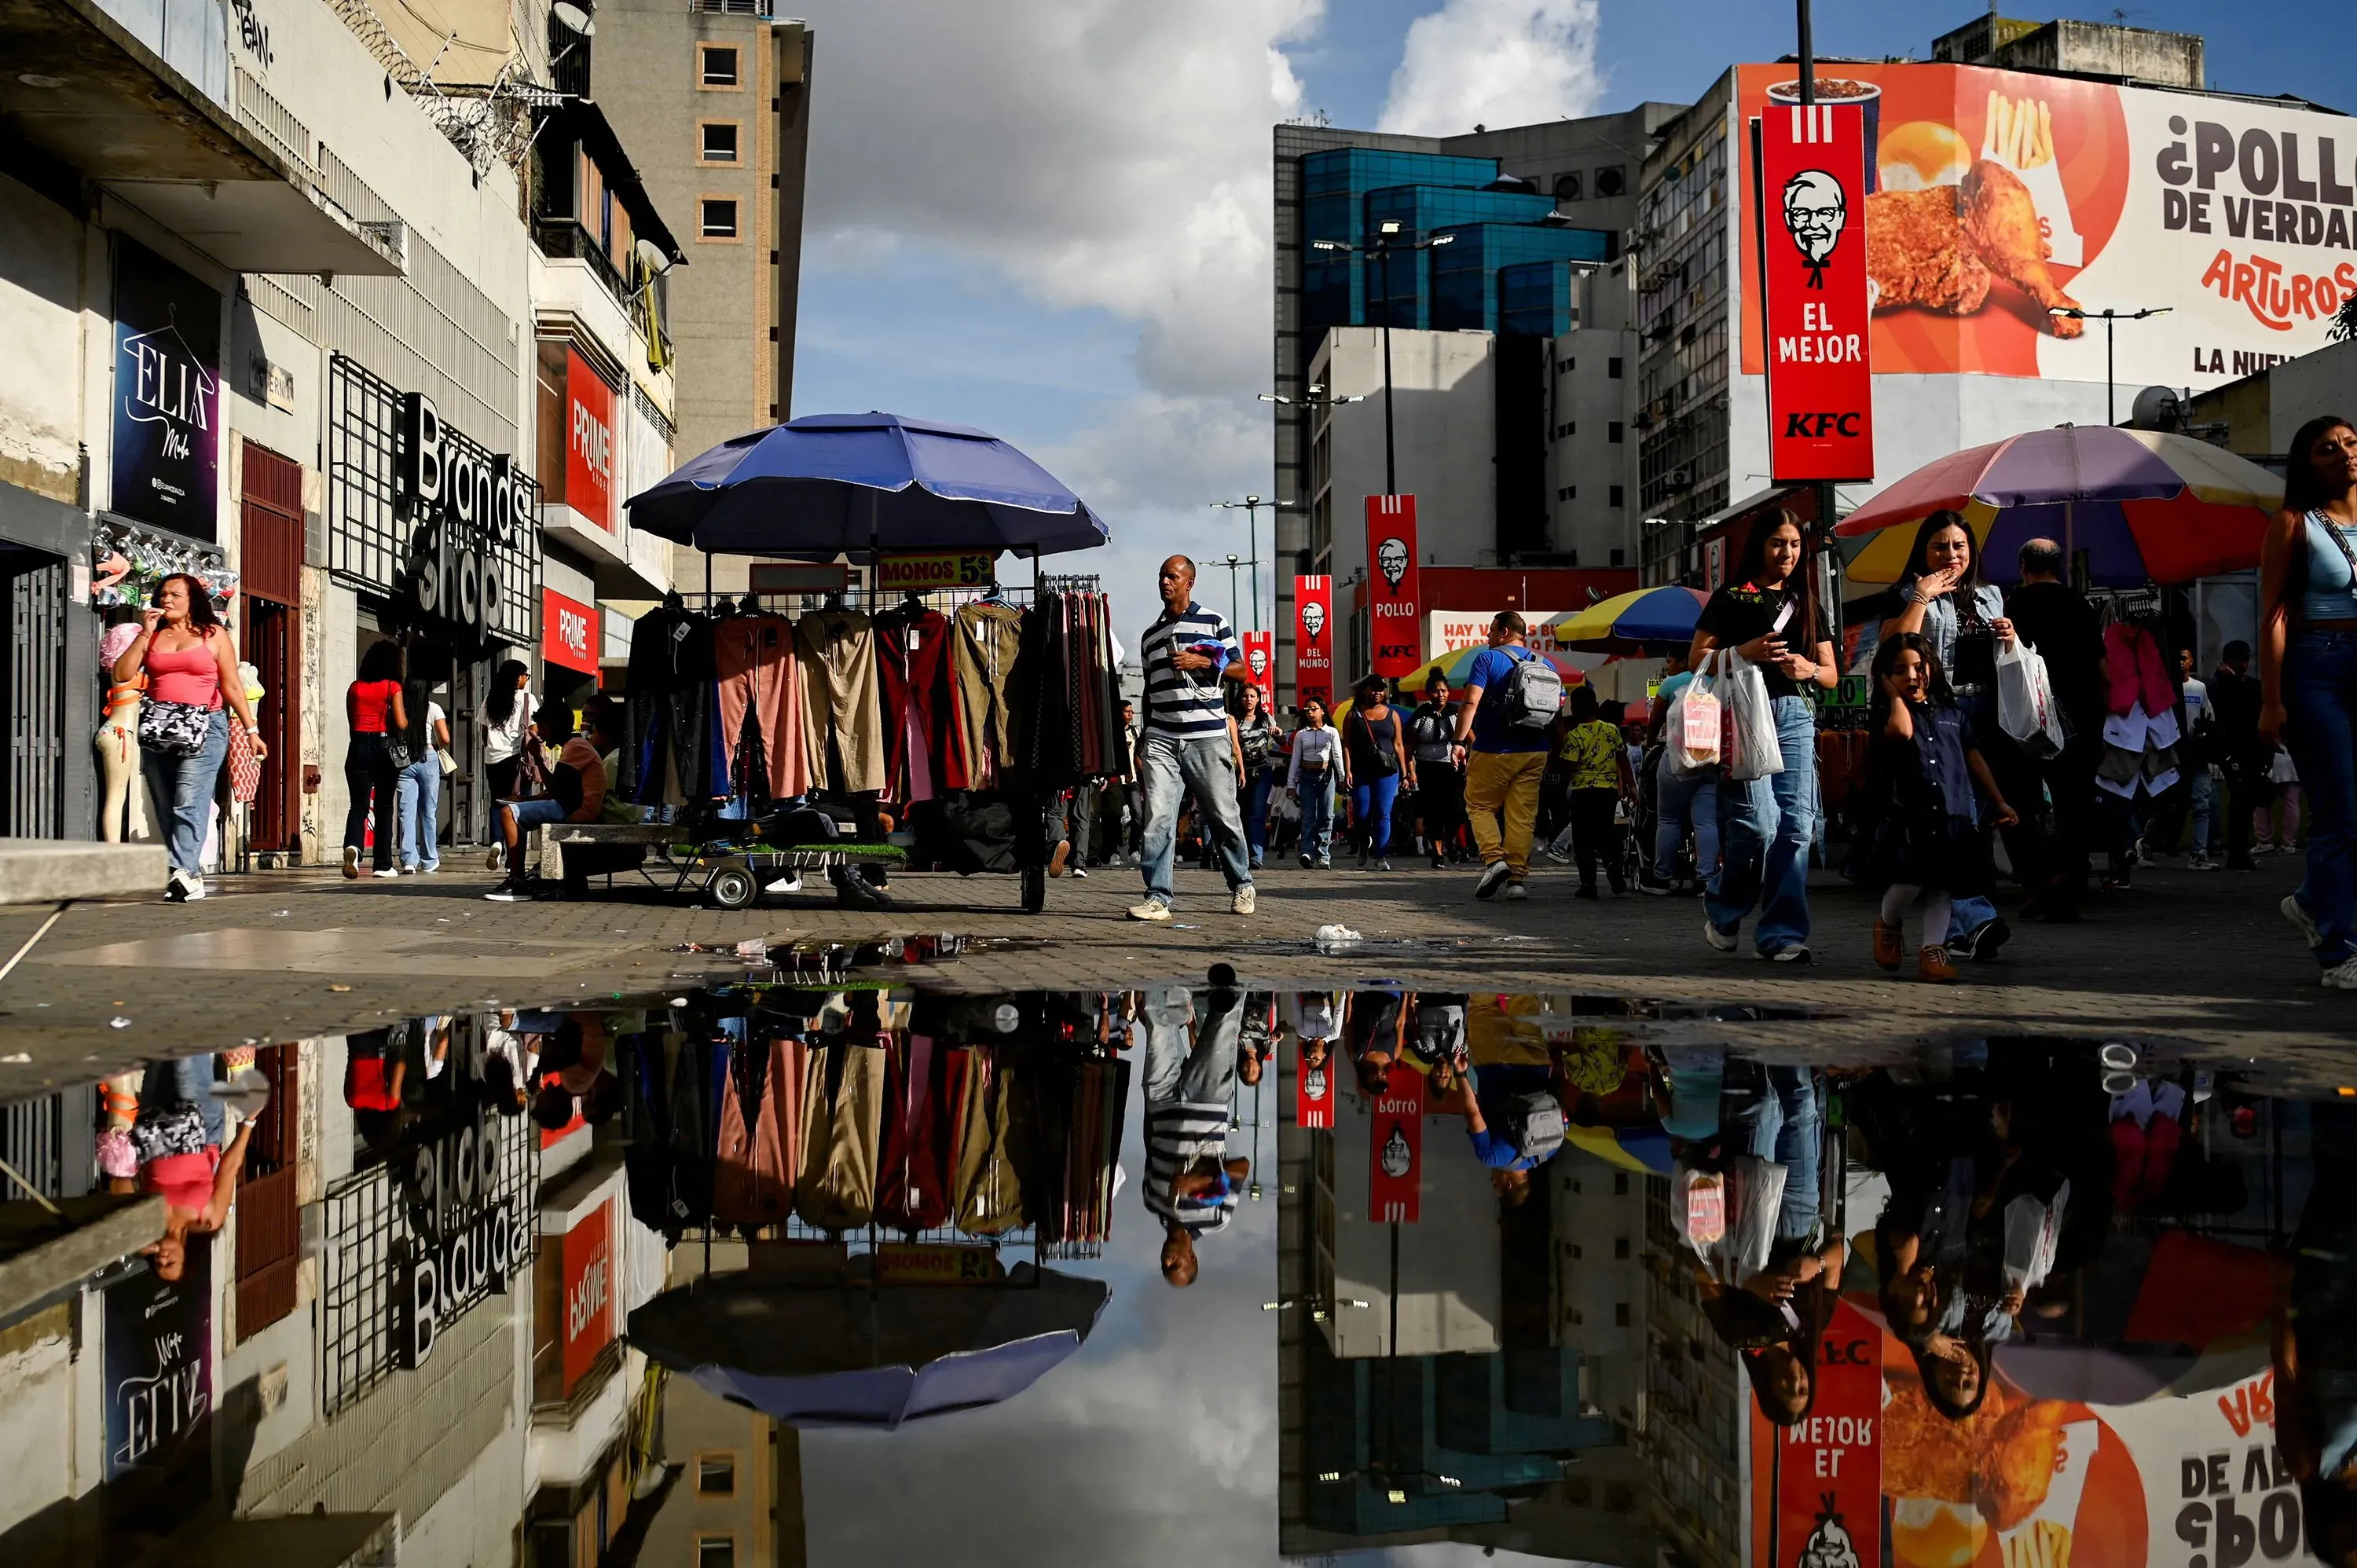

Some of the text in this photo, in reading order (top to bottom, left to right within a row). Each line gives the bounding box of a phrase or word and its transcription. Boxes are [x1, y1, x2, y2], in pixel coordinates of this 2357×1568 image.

[2156, 115, 2357, 207] ¿POLL
[2163, 188, 2357, 251] DE VERDA
[1803, 302, 1834, 332] EL
[1779, 334, 1862, 364] MEJOR
[2194, 346, 2297, 376] LA NUE
[136, 342, 207, 431] ELIA
[574, 398, 610, 478] PRIME
[1783, 412, 1861, 438] KFC
[418, 394, 526, 550] Brands
[881, 555, 990, 584] MONOS 5$
[1376, 602, 1414, 617] POLLO
[559, 608, 587, 650] PRIME
[1443, 624, 1474, 636] HAY
[1299, 658, 1329, 669] MUNDO
[1307, 648, 1321, 658] DEL
[1378, 644, 1416, 658] KFC
[1301, 686, 1329, 696] KFC
